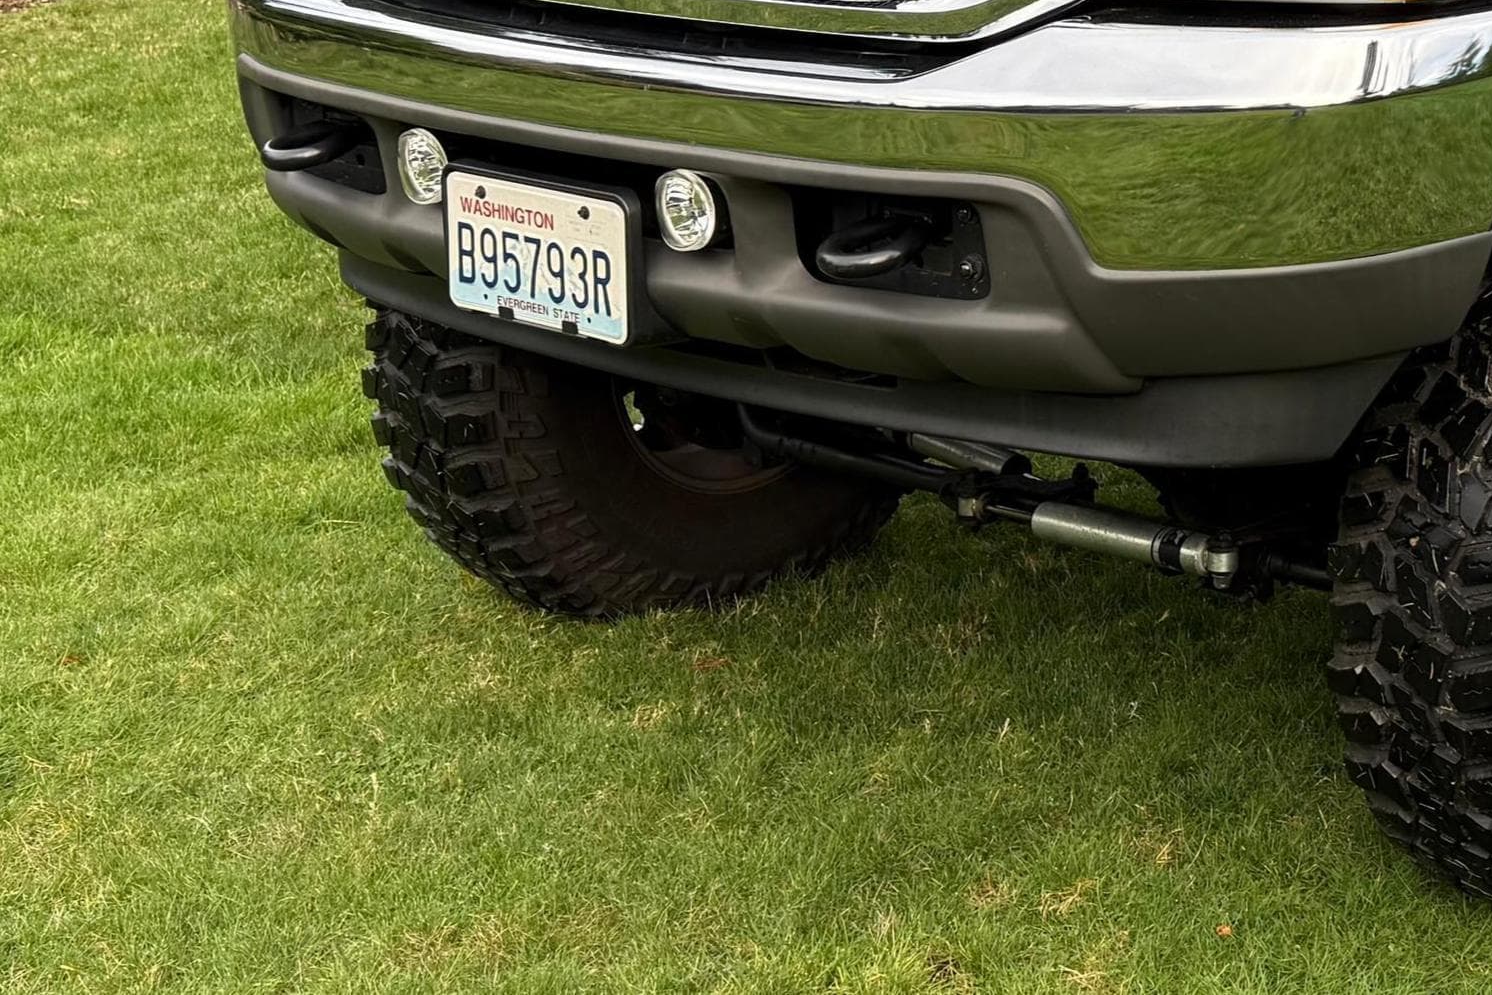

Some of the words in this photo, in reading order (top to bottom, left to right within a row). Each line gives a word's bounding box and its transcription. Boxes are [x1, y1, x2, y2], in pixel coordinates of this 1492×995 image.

[460, 196, 555, 231] WASHINGTON
[457, 221, 612, 317] B95793R
[496, 295, 549, 315] EVERGREEN
[553, 308, 580, 324] STATE
